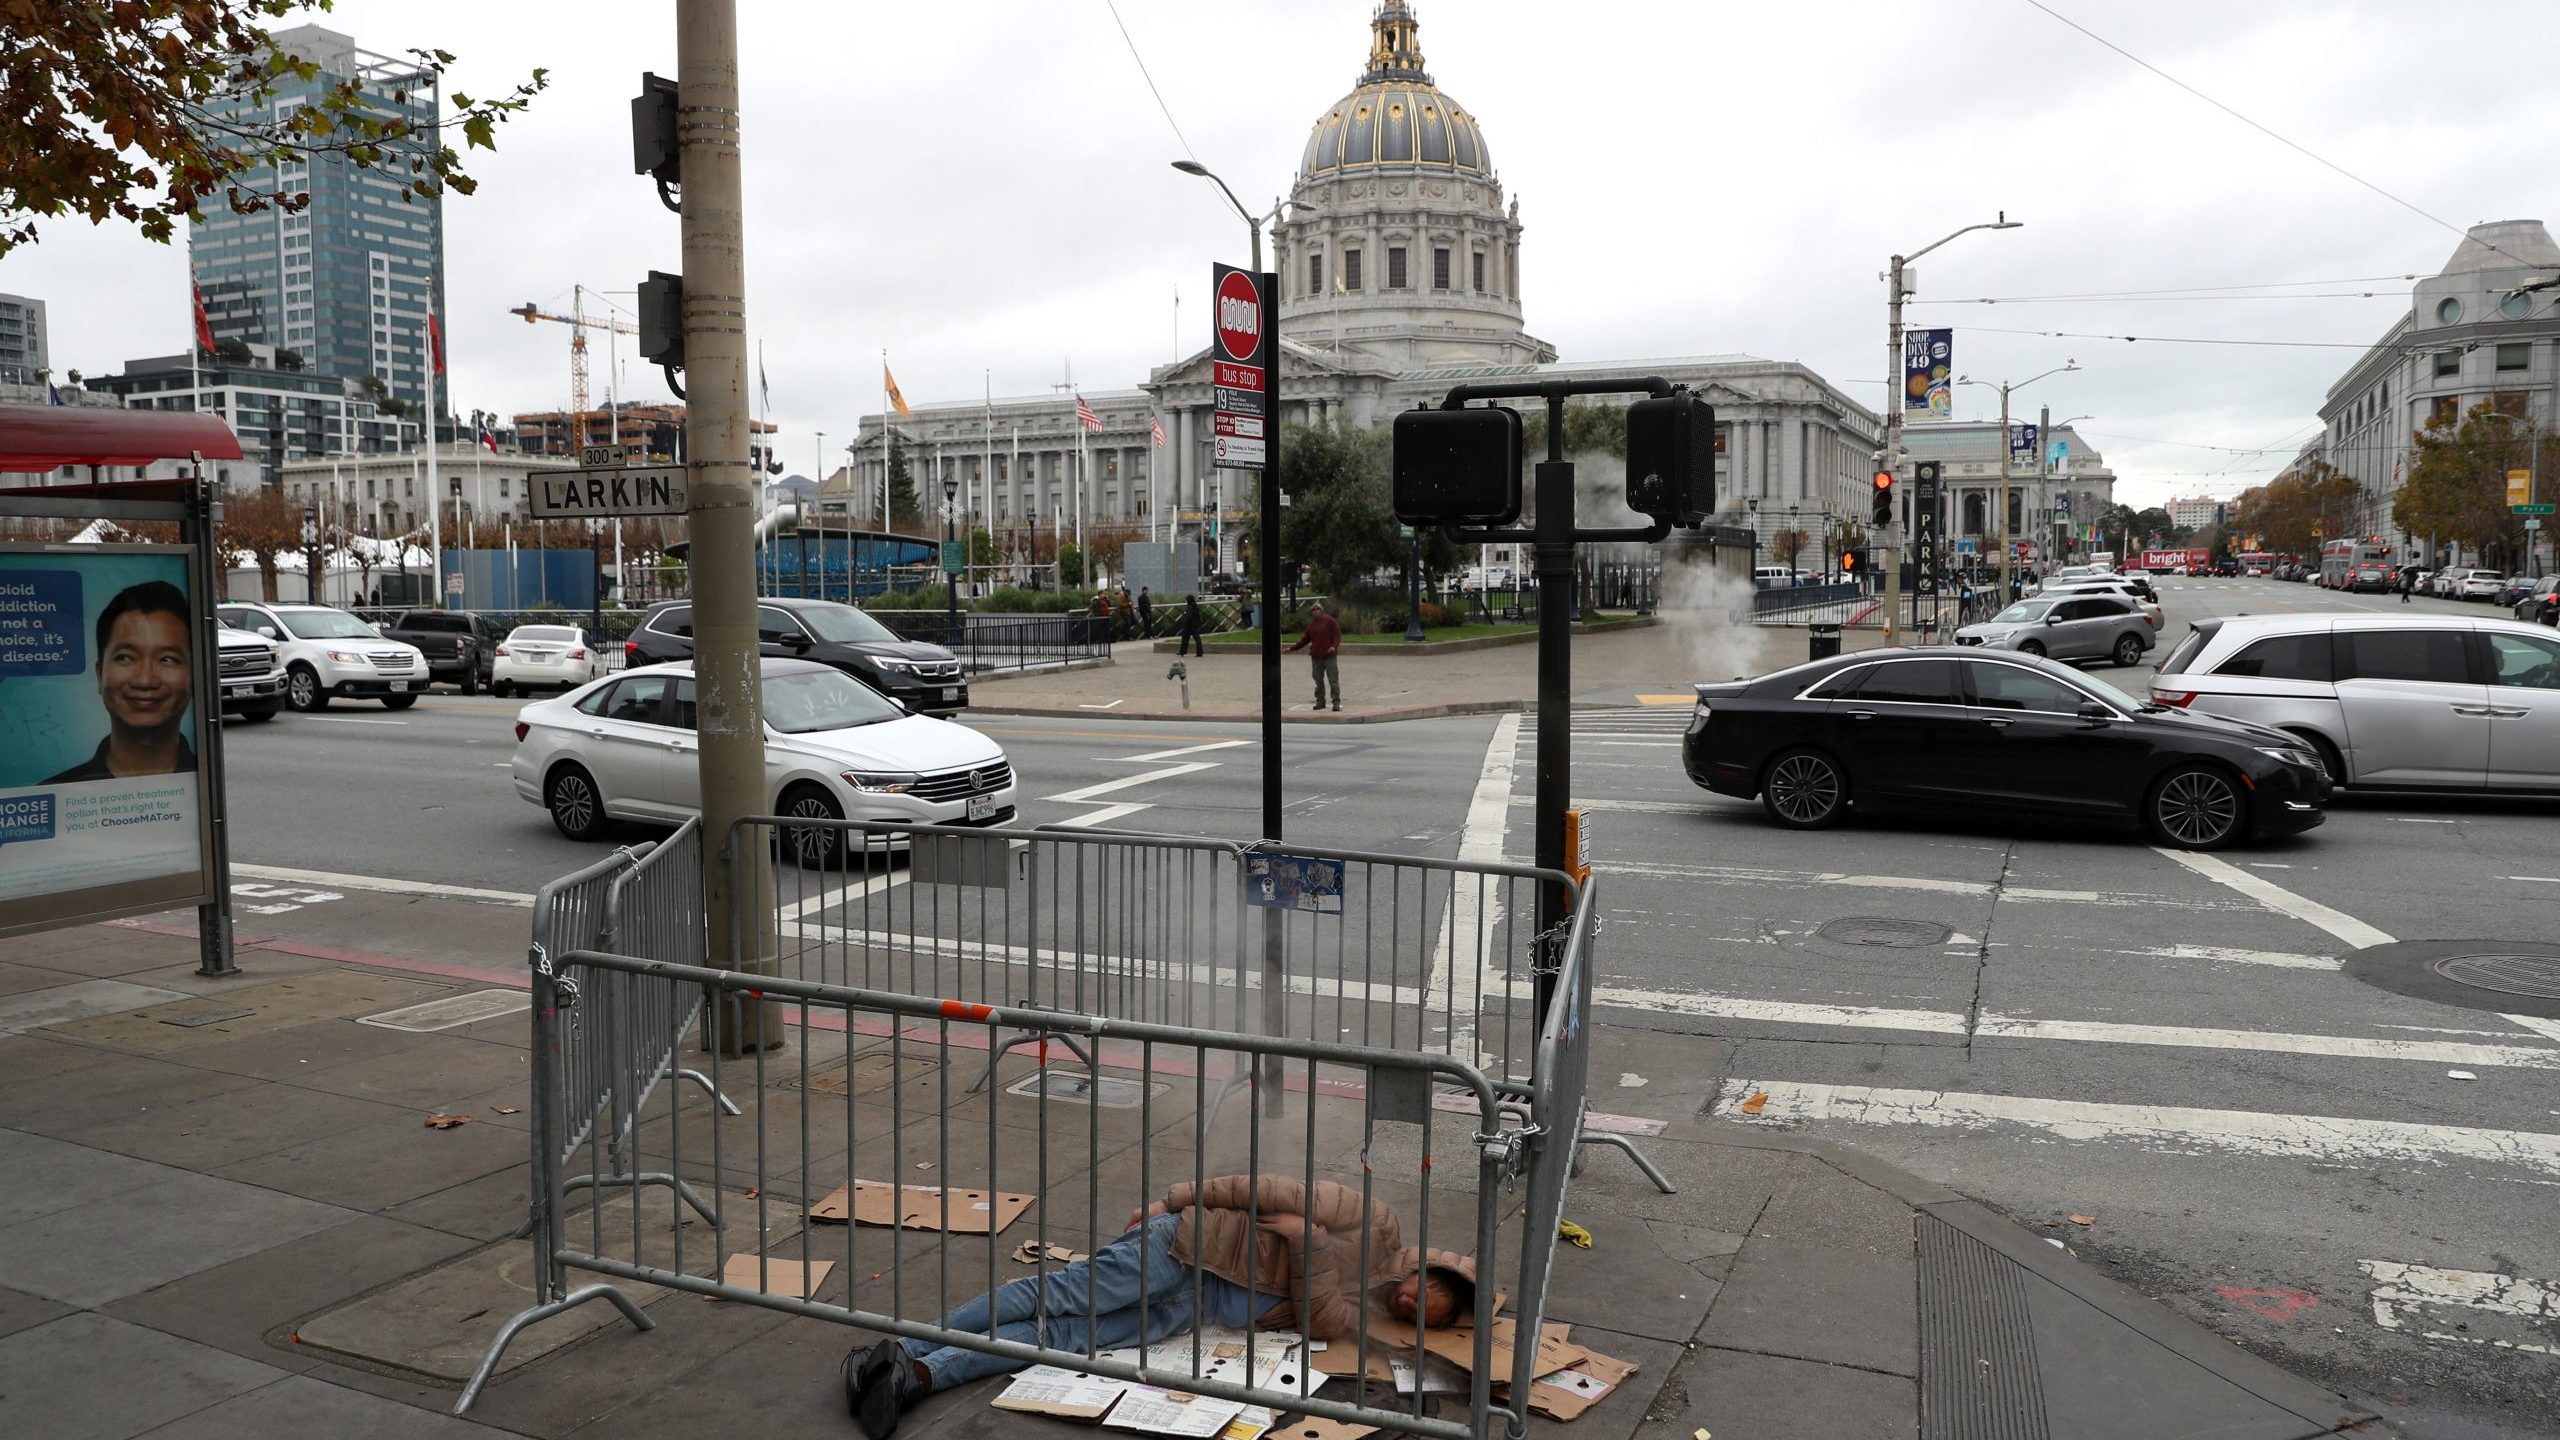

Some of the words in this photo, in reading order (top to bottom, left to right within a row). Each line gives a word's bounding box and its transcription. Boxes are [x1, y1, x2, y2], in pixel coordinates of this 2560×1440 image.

[1907, 331, 1930, 343] SHOP
[1907, 343, 1930, 355] DINE
[1907, 355, 1930, 368] 49
[1222, 364, 1237, 382] bus
[1239, 369, 1257, 390] stop
[1216, 388, 1227, 409] 19
[585, 448, 609, 464] 300
[544, 476, 670, 509] LARKIN
[1920, 514, 1932, 574] PARK
[2149, 552, 2186, 566] bright
[3, 618, 28, 628] not
[32, 620, 44, 628] a
[44, 634, 64, 645] it's
[66, 797, 87, 806] Find
[99, 794, 135, 806] proven
[136, 788, 185, 800] treatment
[66, 808, 98, 820] option
[100, 804, 128, 814] that's
[131, 800, 154, 813] right
[156, 800, 170, 810] for
[66, 822, 85, 834] you
[88, 820, 99, 830] at
